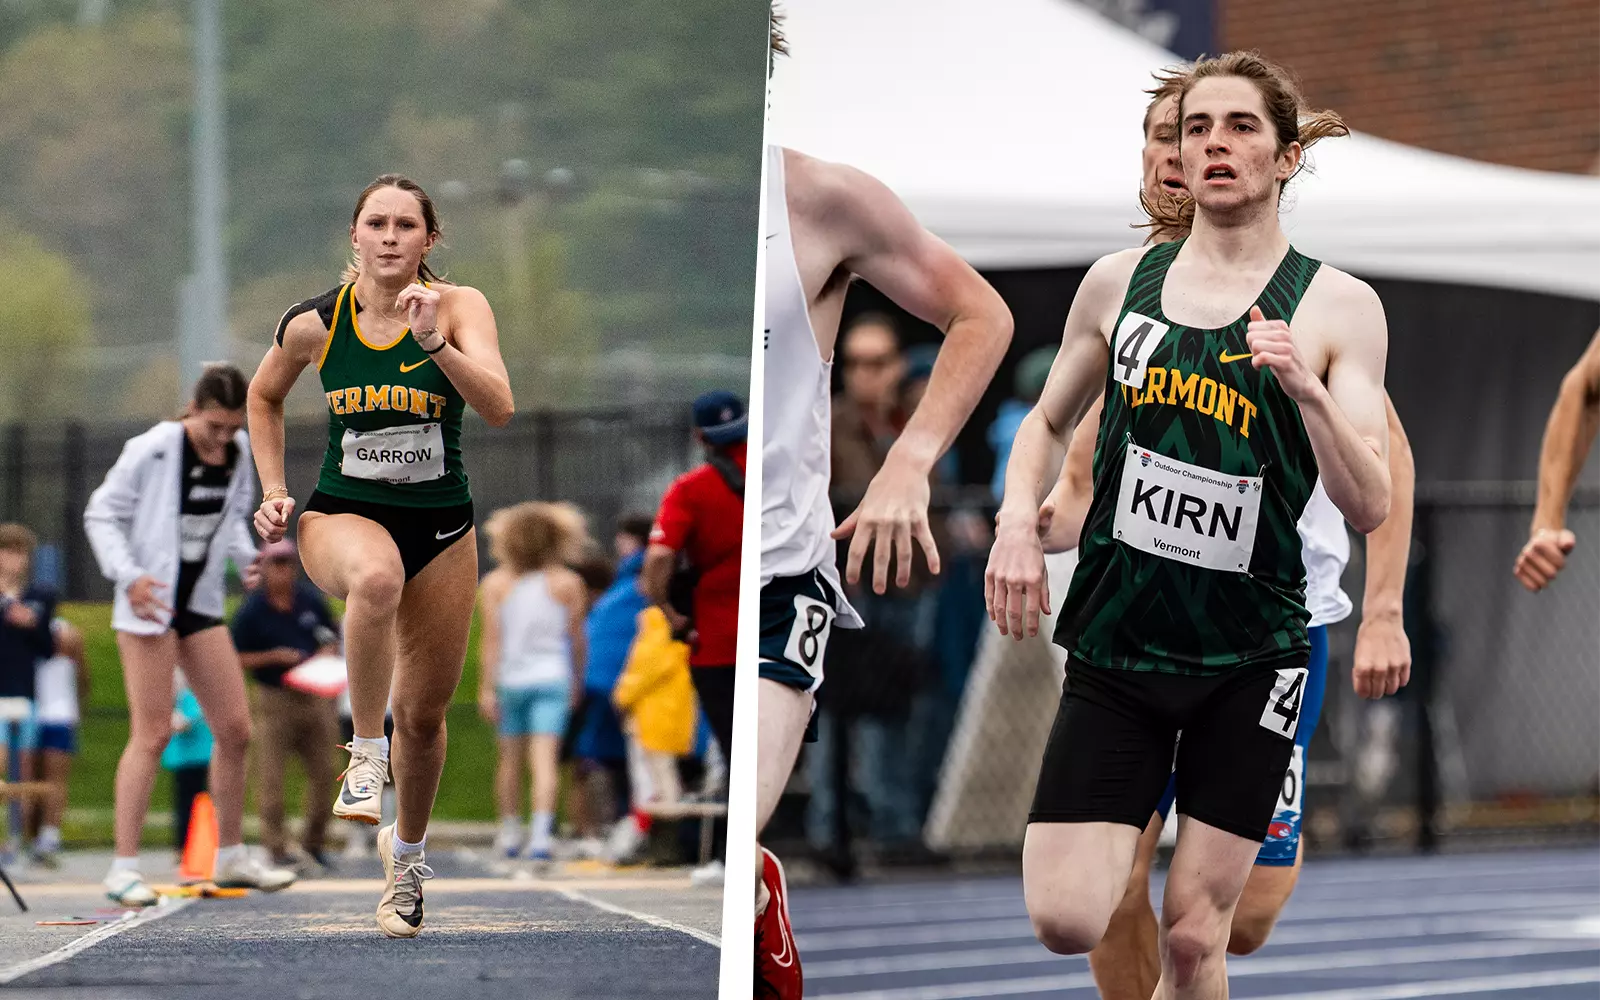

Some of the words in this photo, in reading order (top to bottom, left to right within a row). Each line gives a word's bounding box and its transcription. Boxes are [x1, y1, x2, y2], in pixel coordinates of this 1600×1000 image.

[1118, 321, 1154, 380] 4
[356, 447, 432, 464] GARROW
[1154, 461, 1182, 475] Outdoor
[1182, 469, 1233, 490] Championship
[1130, 478, 1243, 542] KIRN
[1153, 537, 1201, 560] Vermont
[798, 604, 828, 667] 8
[1273, 671, 1304, 733] 4
